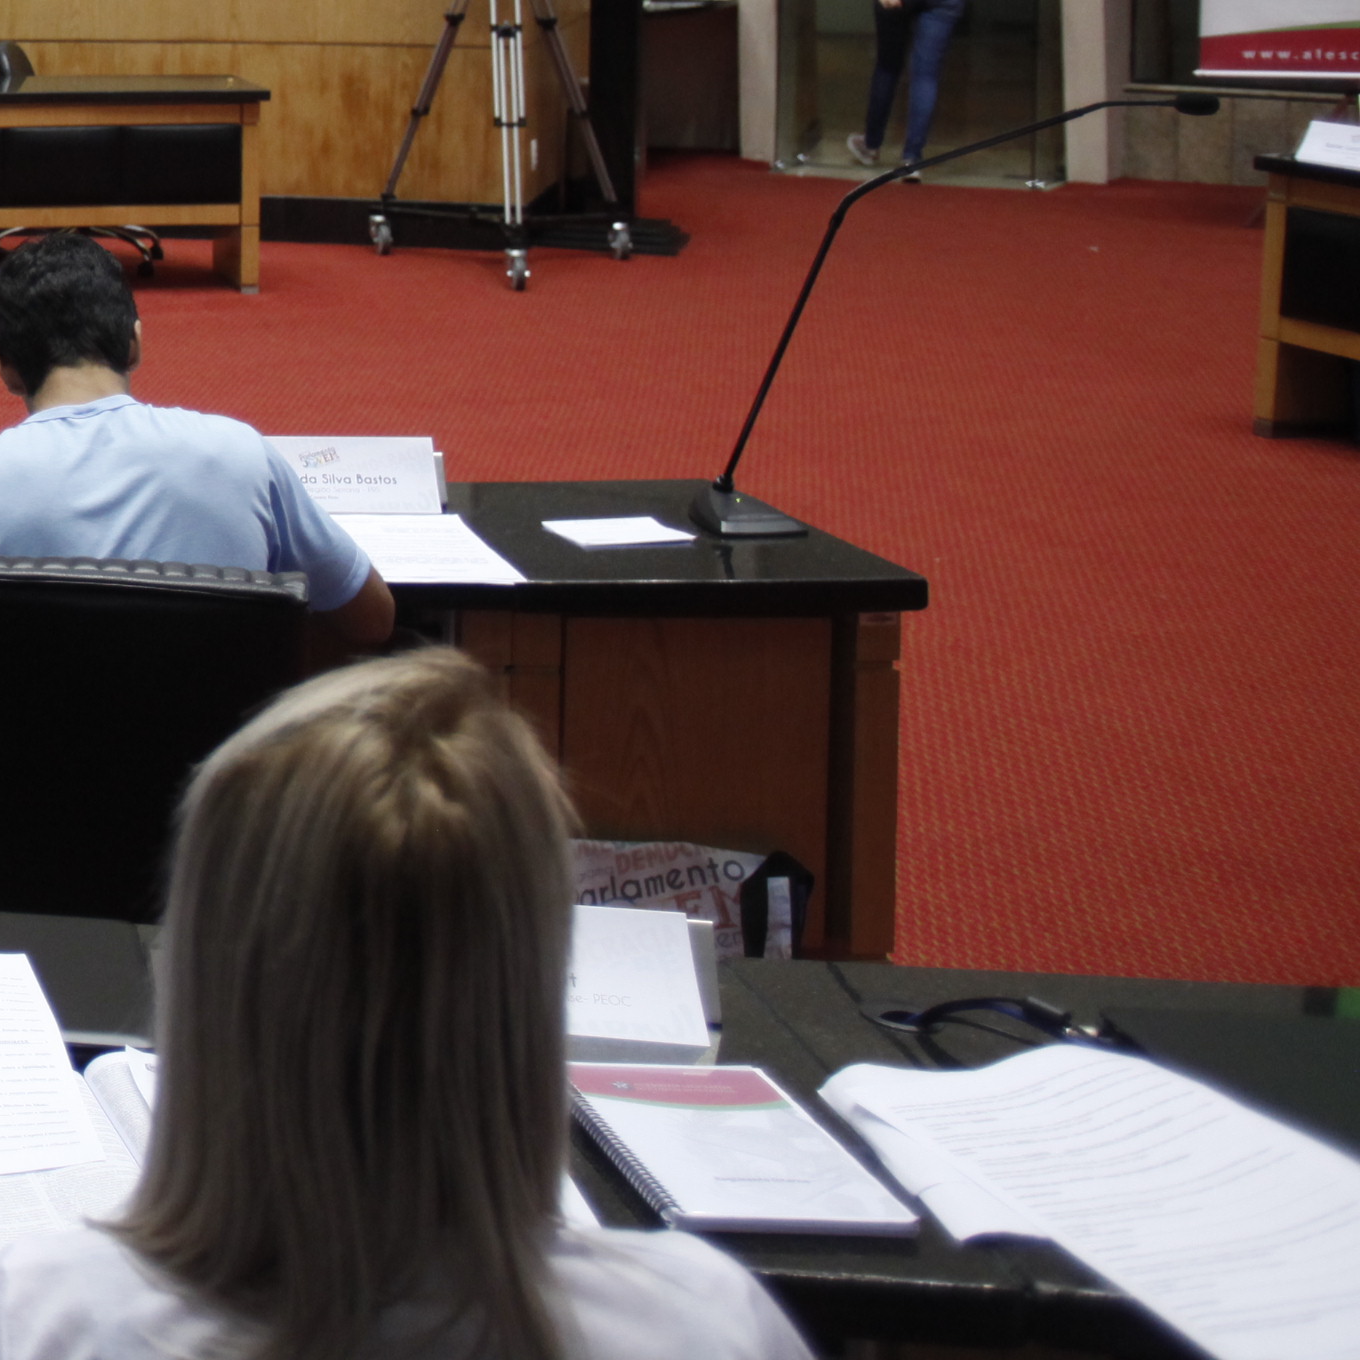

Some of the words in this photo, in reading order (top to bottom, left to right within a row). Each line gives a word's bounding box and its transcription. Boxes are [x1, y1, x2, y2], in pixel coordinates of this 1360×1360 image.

[322, 473, 352, 485] Silva
[356, 474, 398, 485] Bastos
[577, 857, 745, 907] arlamento
